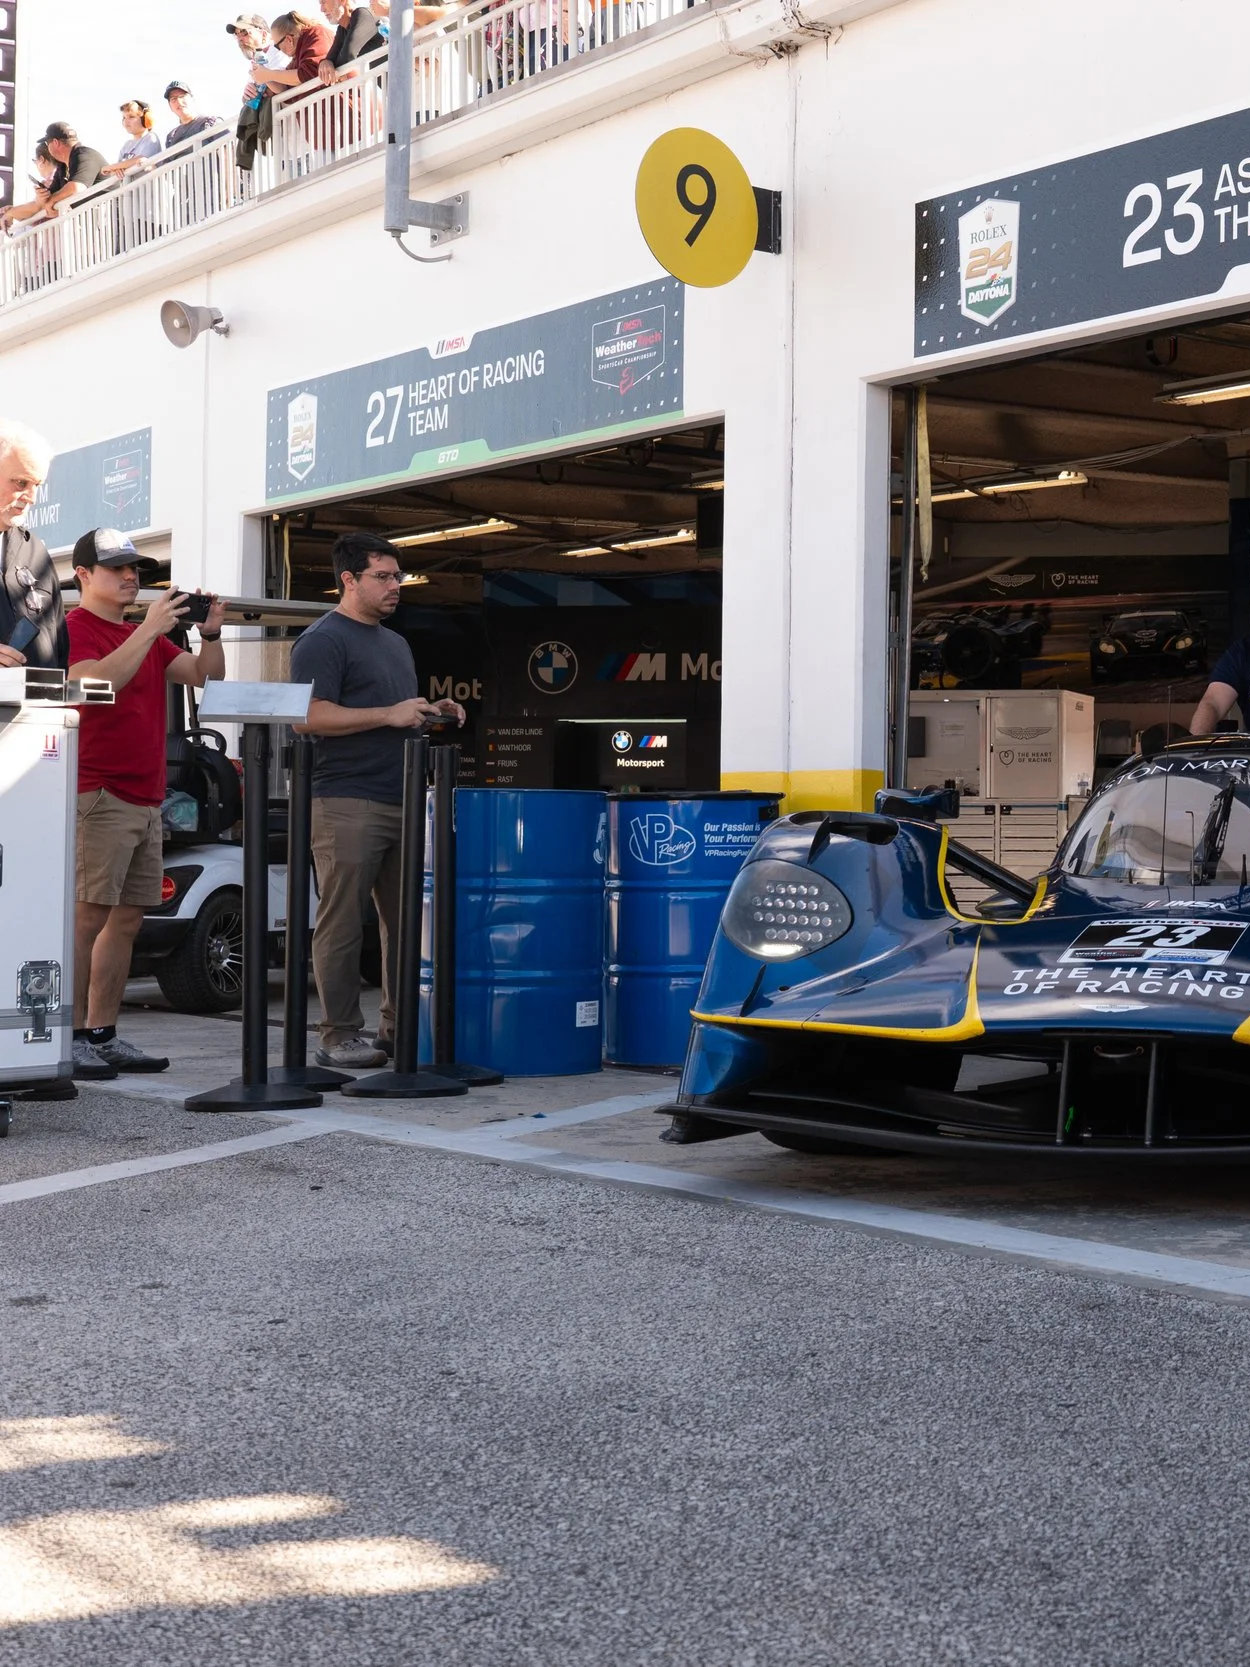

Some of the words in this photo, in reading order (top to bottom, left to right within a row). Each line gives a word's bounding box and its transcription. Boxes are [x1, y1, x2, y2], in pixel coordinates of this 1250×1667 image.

[676, 163, 717, 248] 9
[1122, 168, 1205, 269] 23
[970, 224, 1008, 245] ROLEX
[964, 240, 1013, 281] 24
[967, 283, 1010, 305] DAYTONA
[444, 336, 466, 352] IMSA
[595, 330, 663, 358] WeatherTech
[408, 372, 456, 408] HEART
[458, 366, 480, 395] OF
[483, 349, 545, 389] RACING
[366, 384, 404, 449] 27
[407, 404, 449, 437] TEAM
[290, 422, 314, 448] 24
[437, 448, 459, 464] GTD
[40, 503, 61, 526] WRT
[535, 643, 571, 660] BMW
[497, 728, 511, 736] VAN
[511, 728, 524, 736] DER
[524, 728, 543, 736] LINDE
[497, 743, 532, 752] VANTHOOR
[616, 758, 665, 769] Motorsport
[497, 775, 514, 783] RAST
[703, 822, 721, 832] Our
[721, 822, 754, 832] Passion
[754, 822, 761, 832] is
[630, 813, 675, 864] VP
[703, 834, 725, 843] Your
[725, 834, 760, 843] Perform
[658, 840, 695, 860] Racing
[1164, 900, 1228, 910] IMSA
[1100, 919, 1243, 927] WeatherTech
[1103, 925, 1212, 947] 23
[1011, 967, 1094, 981] THE
[1003, 981, 1060, 995] OF
[1075, 980, 1246, 999] RACING
